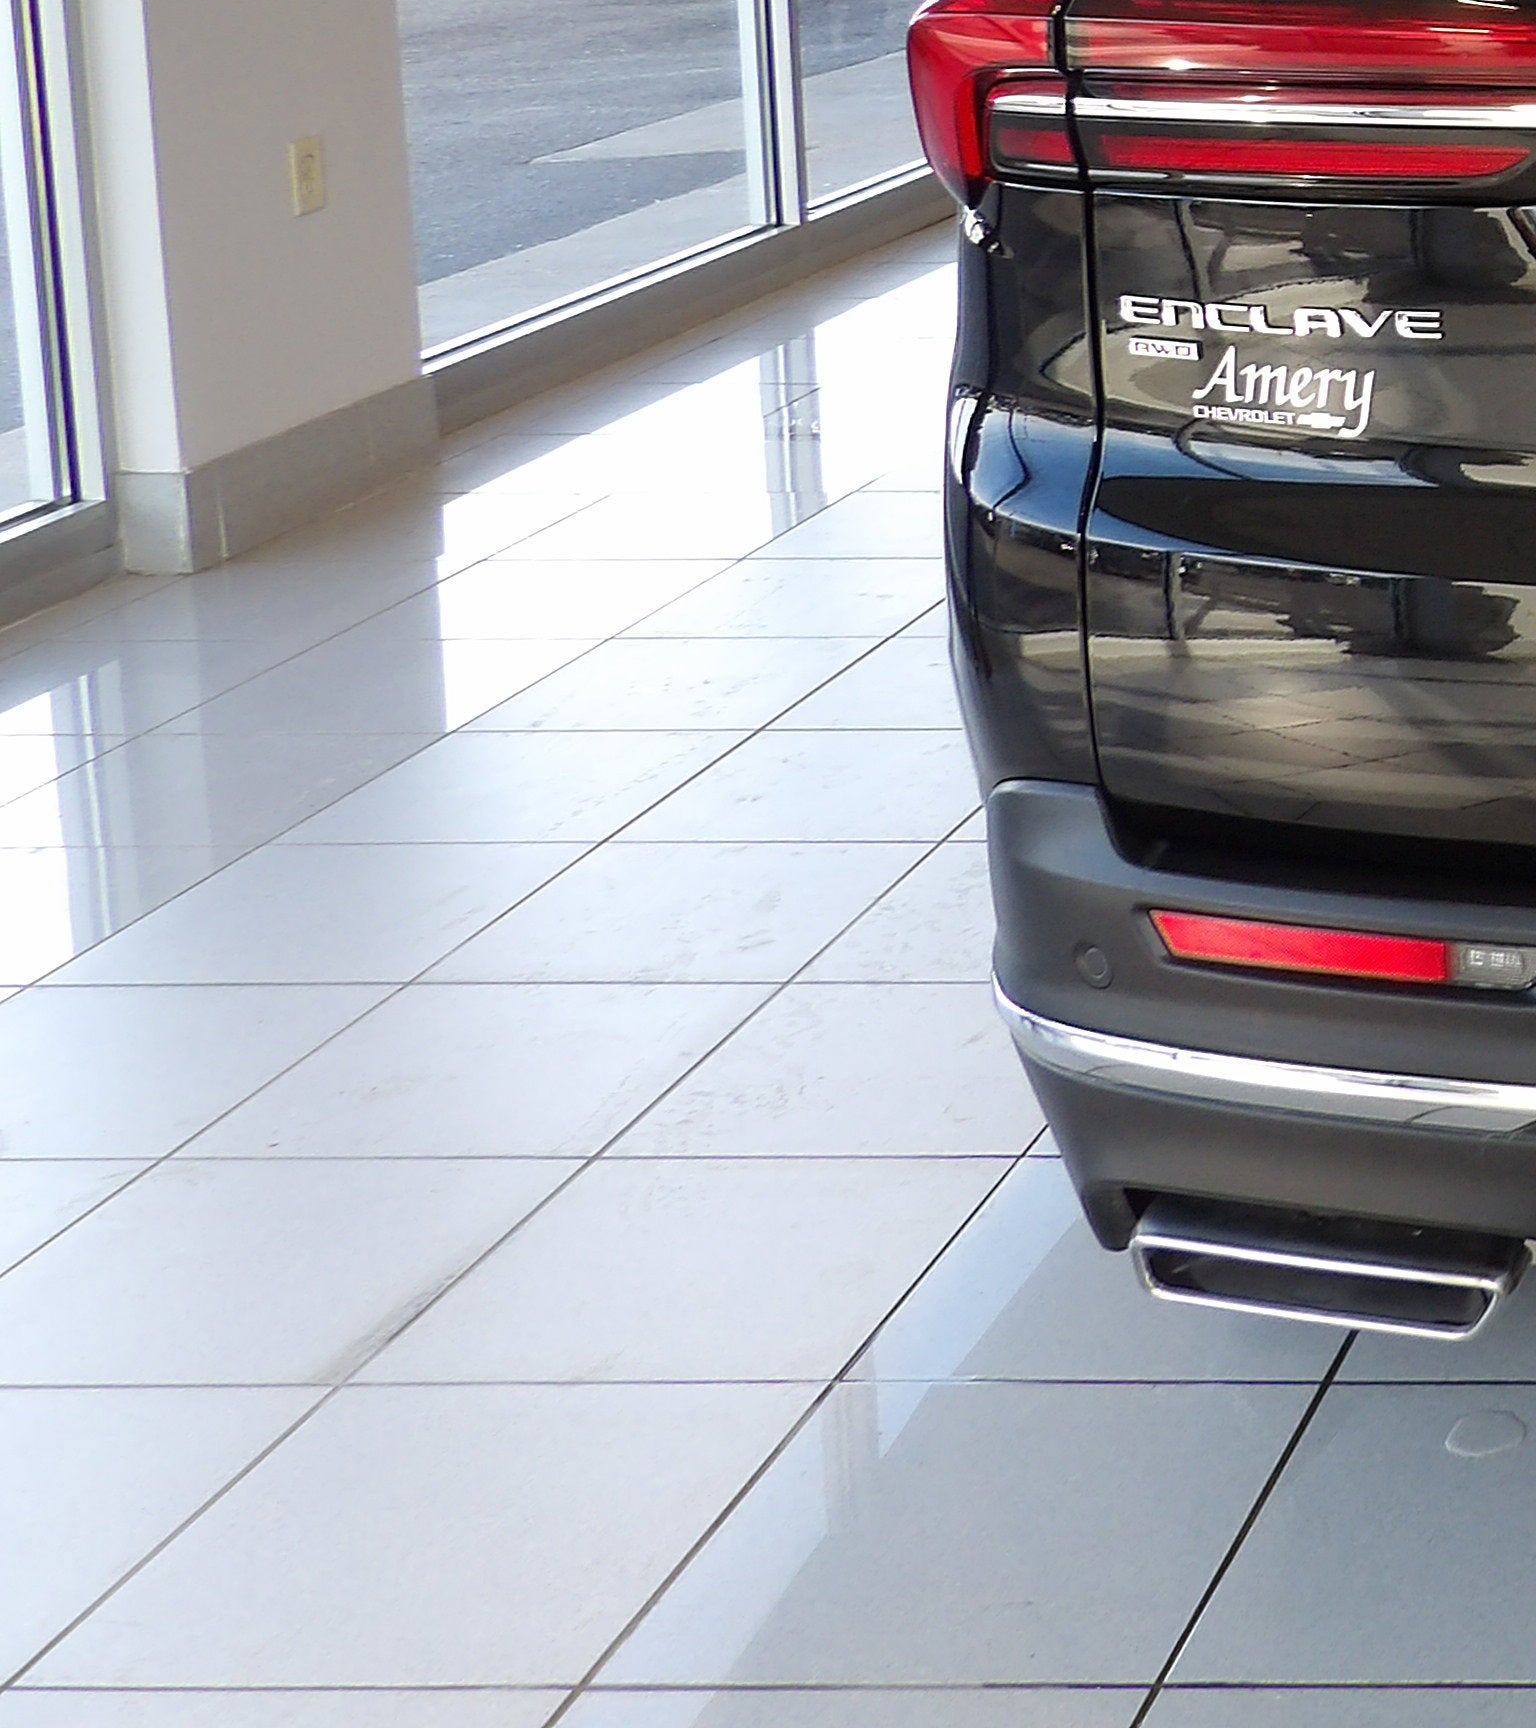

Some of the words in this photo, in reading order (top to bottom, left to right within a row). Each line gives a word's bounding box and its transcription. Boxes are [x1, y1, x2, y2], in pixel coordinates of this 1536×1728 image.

[1118, 294, 1444, 339] ENCLAVE
[1132, 340, 1194, 358] AWD
[1191, 344, 1375, 438] Amery
[1193, 404, 1297, 425] CHEVROLET
